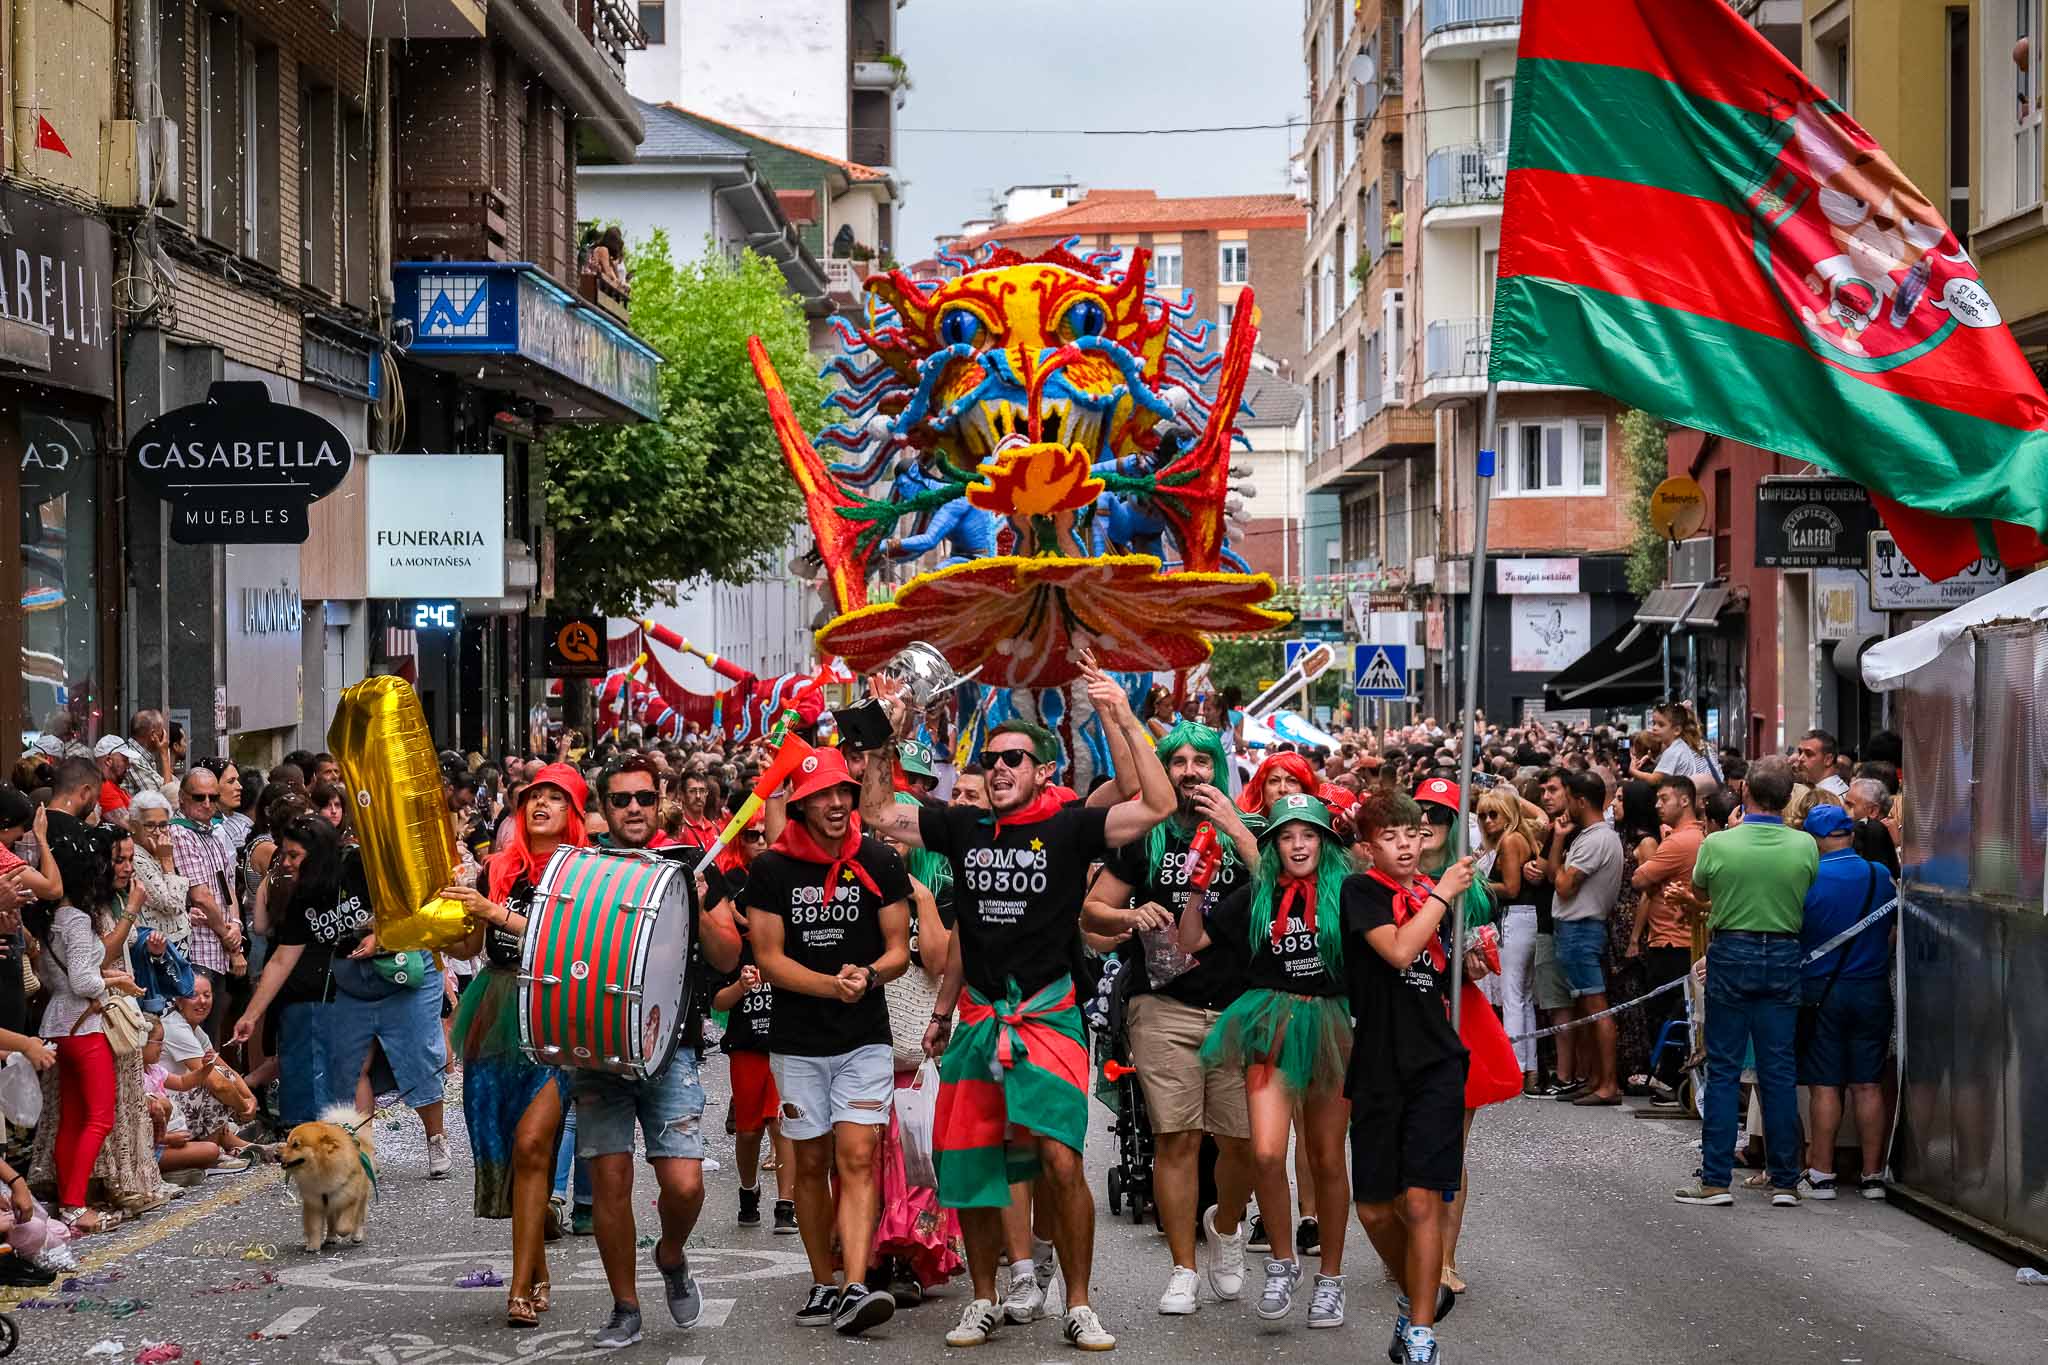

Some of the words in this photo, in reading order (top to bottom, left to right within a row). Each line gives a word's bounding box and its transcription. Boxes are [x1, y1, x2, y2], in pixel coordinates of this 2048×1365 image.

[138, 441, 340, 469] CASABELLA
[1760, 487, 1807, 501] LIMPIEZAS
[1810, 487, 1822, 501] EN
[1824, 487, 1867, 501] GENERAL
[186, 509, 289, 525] MUEBLES
[377, 530, 485, 546] FUNERARIA
[1792, 528, 1831, 547] GARFER
[390, 557, 402, 567] LA
[405, 555, 472, 567] MONTAÑESA
[965, 870, 1047, 893] 39300
[792, 904, 859, 924] 39300
